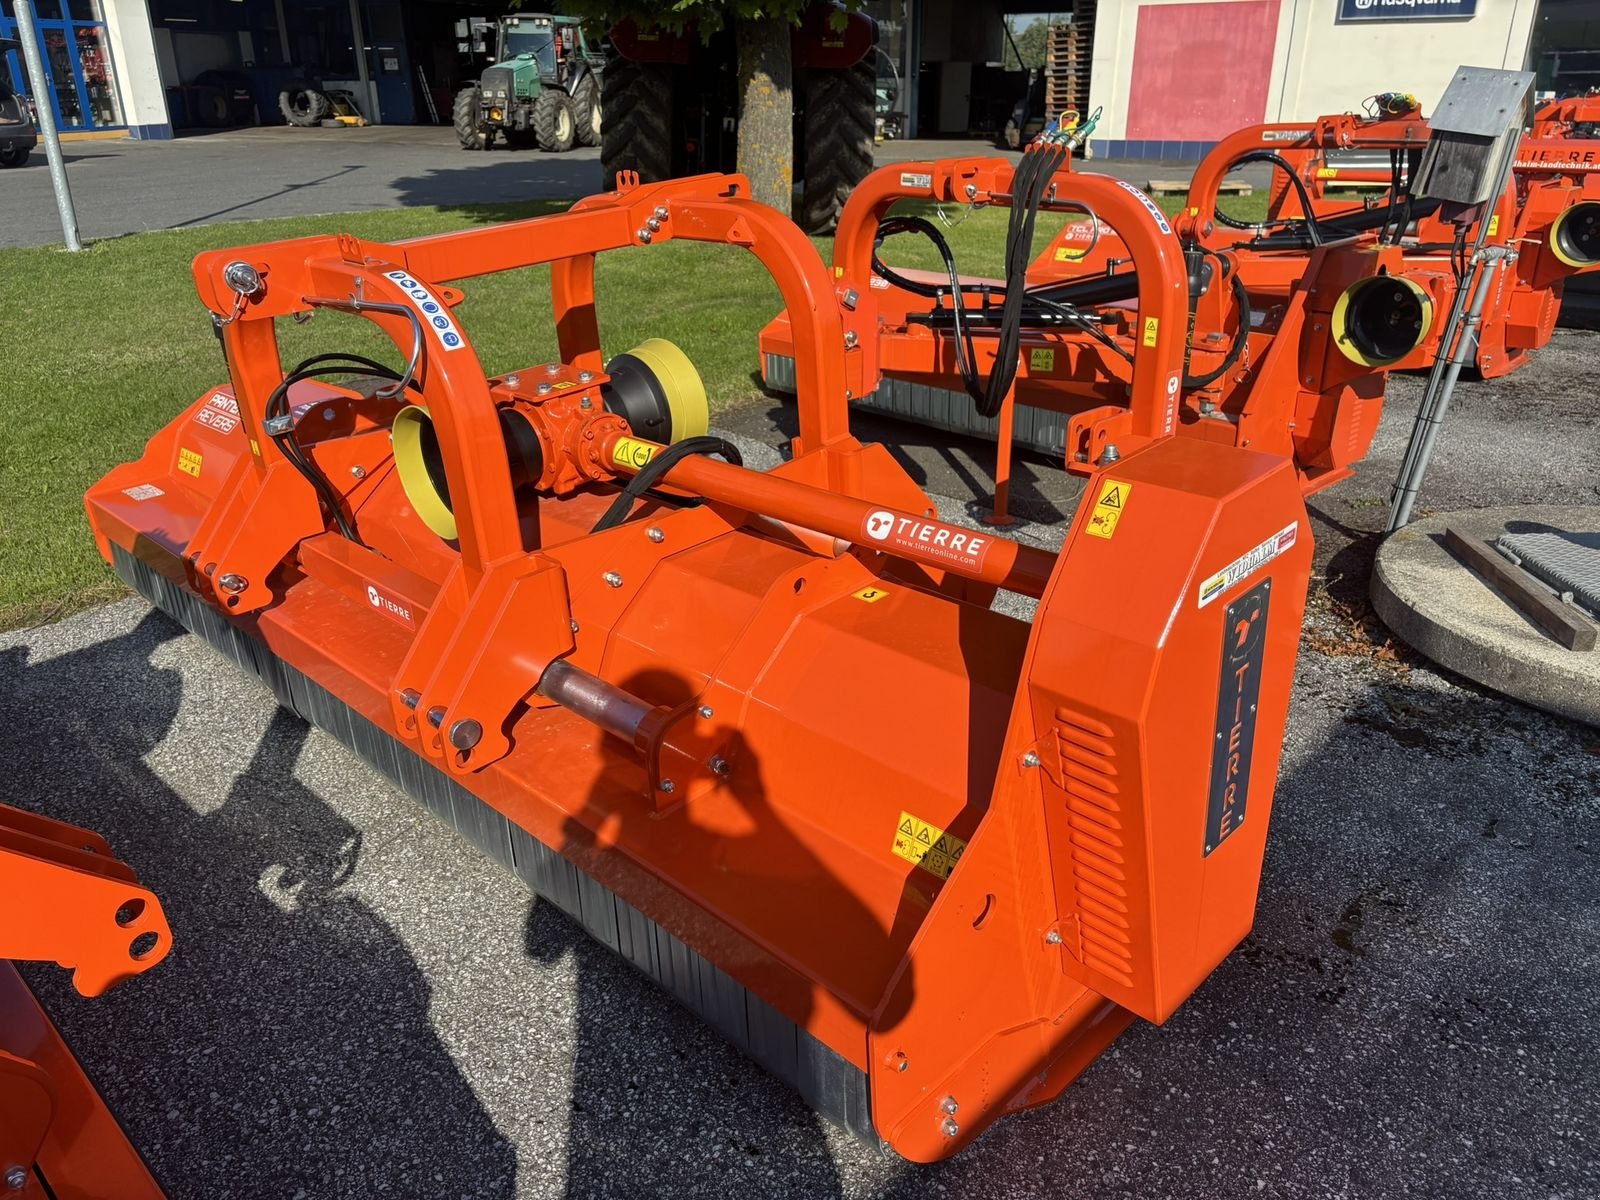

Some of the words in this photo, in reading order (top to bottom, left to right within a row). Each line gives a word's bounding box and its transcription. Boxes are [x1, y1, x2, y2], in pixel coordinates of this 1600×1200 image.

[208, 393, 240, 416] PANTE
[1165, 395, 1175, 433] TIERR
[196, 408, 236, 432] REVERS
[897, 518, 985, 556] TIERRE
[896, 538, 976, 565] www.tierreonline.com
[379, 596, 410, 620] TIERRE
[1219, 662, 1249, 840] TIERRE
